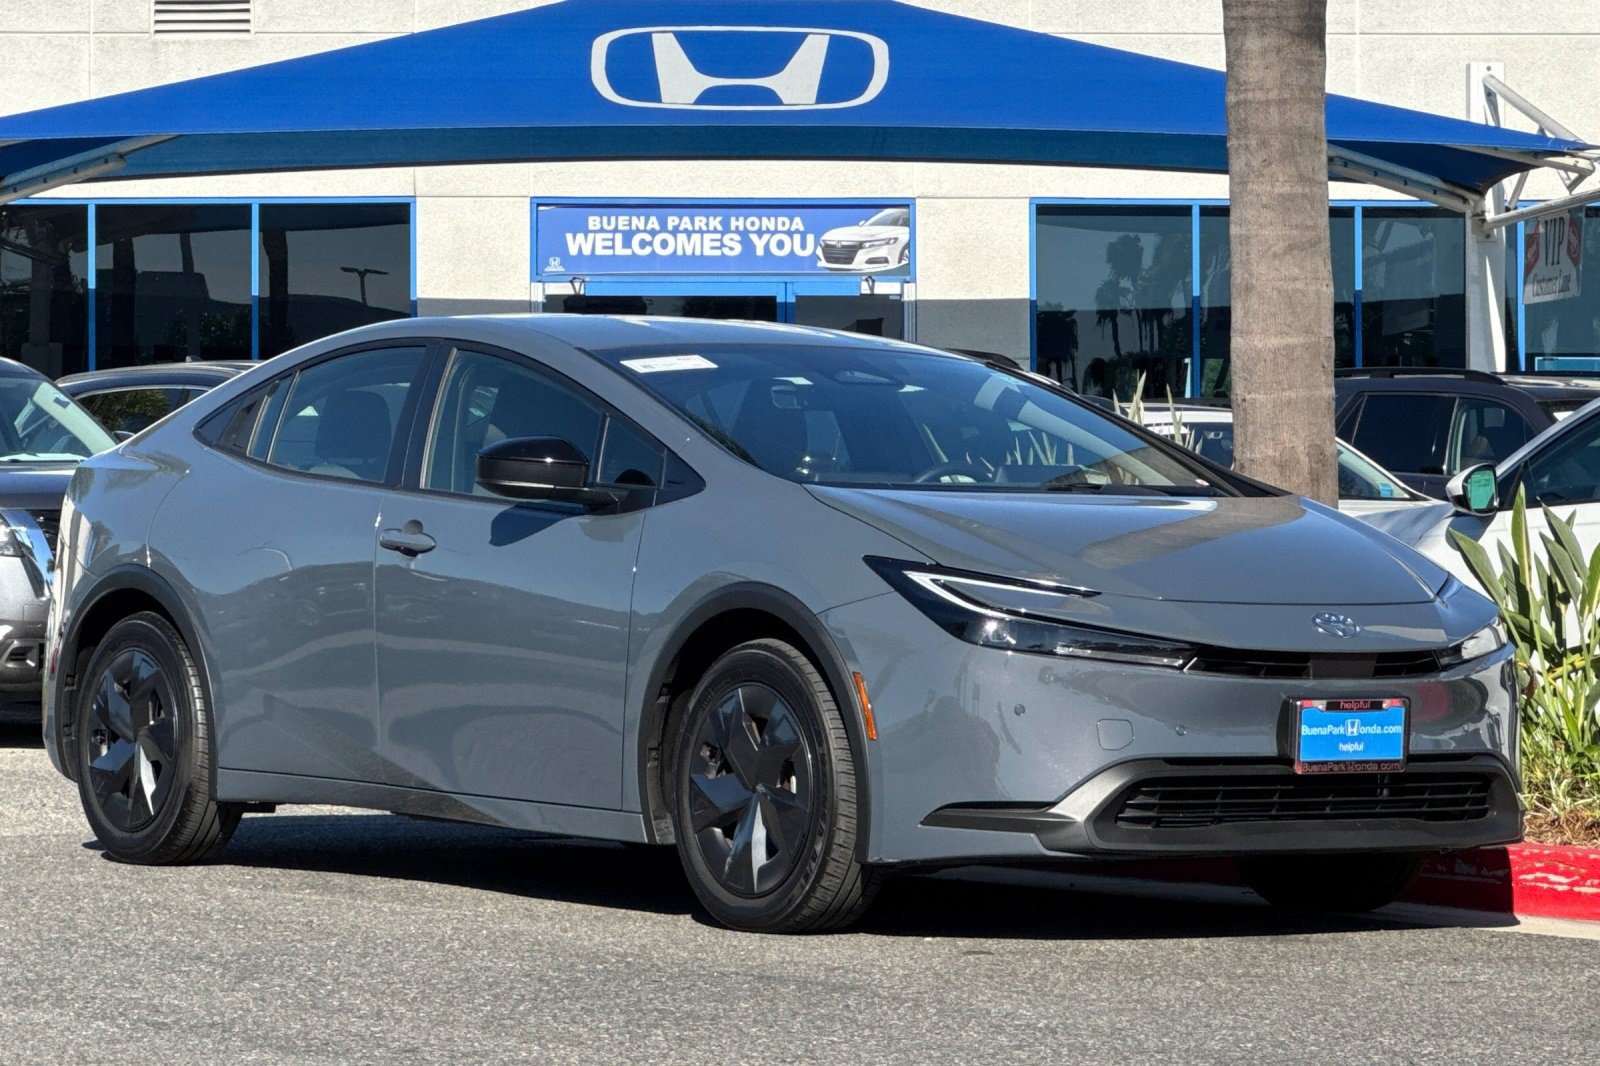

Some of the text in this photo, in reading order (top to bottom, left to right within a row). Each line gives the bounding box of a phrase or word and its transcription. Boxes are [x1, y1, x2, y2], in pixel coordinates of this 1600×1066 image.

[588, 216, 804, 231] BUENA PARK HONDA
[565, 233, 815, 257] WELCOMES YOU
[1544, 216, 1565, 267] VIP
[1340, 699, 1371, 711] helpful
[1339, 742, 1364, 753] helpful
